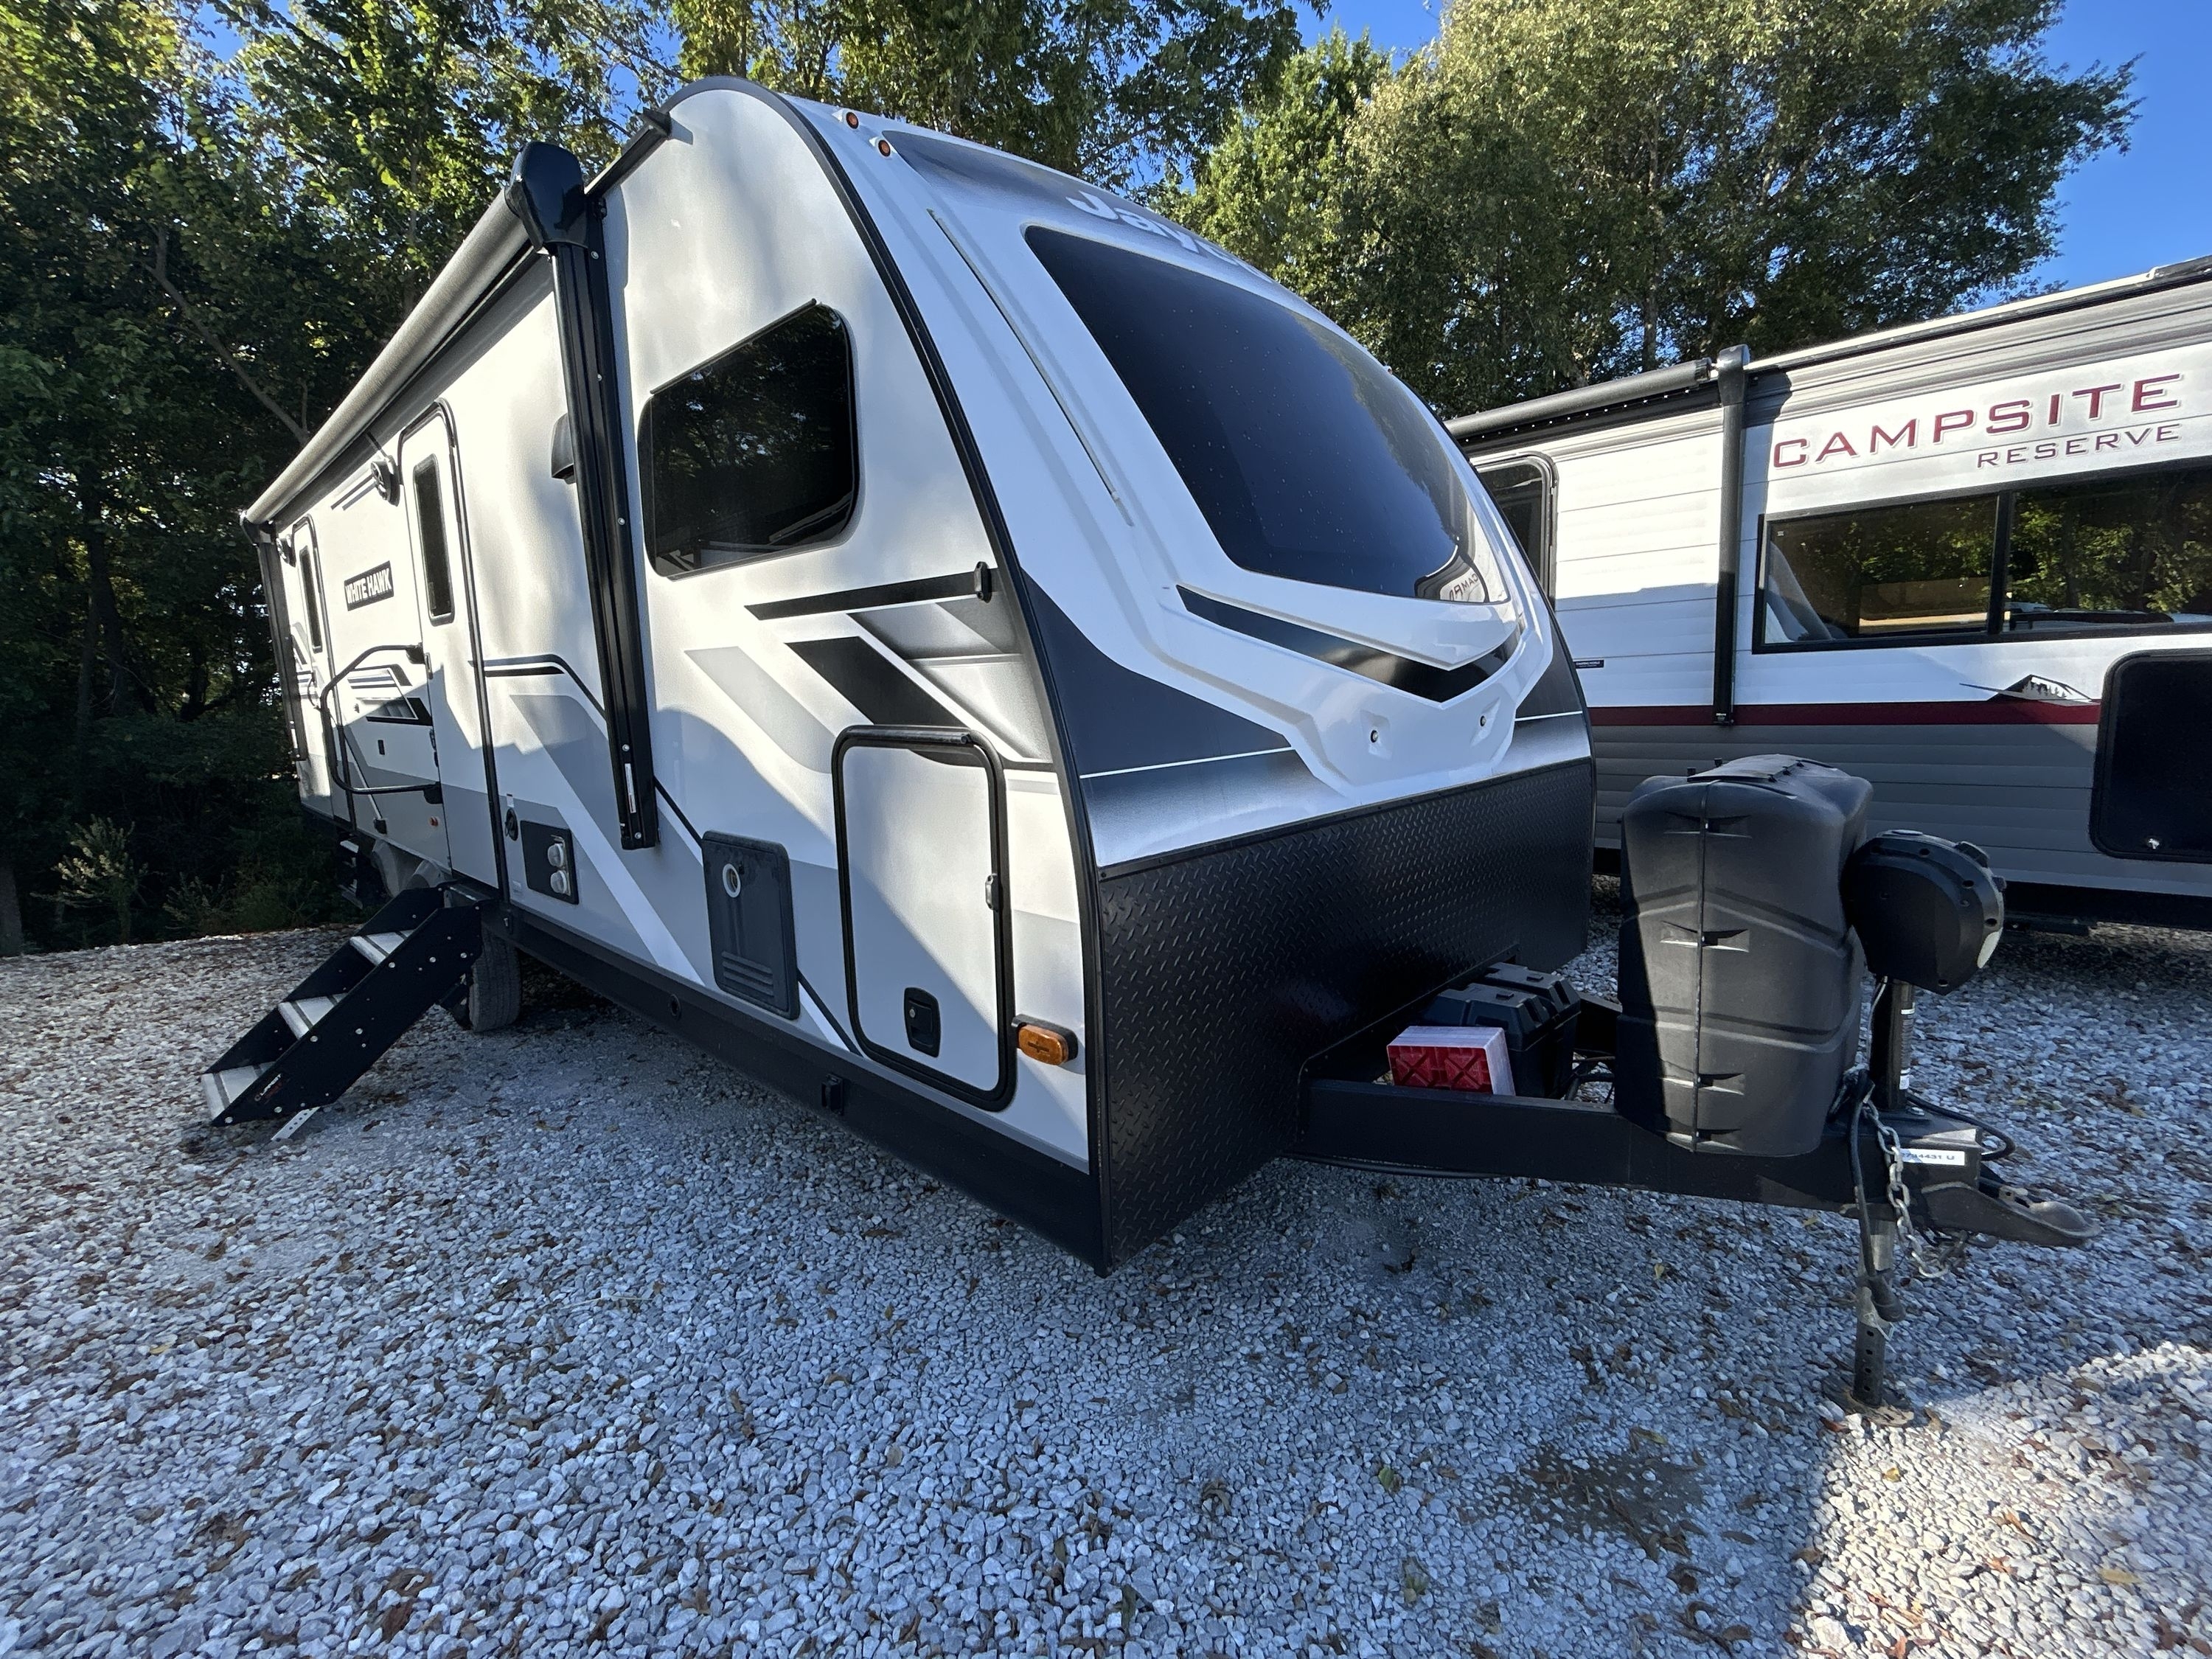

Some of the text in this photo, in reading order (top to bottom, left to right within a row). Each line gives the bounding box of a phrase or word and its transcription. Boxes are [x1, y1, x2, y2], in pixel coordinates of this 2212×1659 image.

[1773, 373, 2182, 468] CAMPSITE
[1977, 423, 2180, 468] RESERVE
[345, 567, 392, 604] WHITE HAWK
